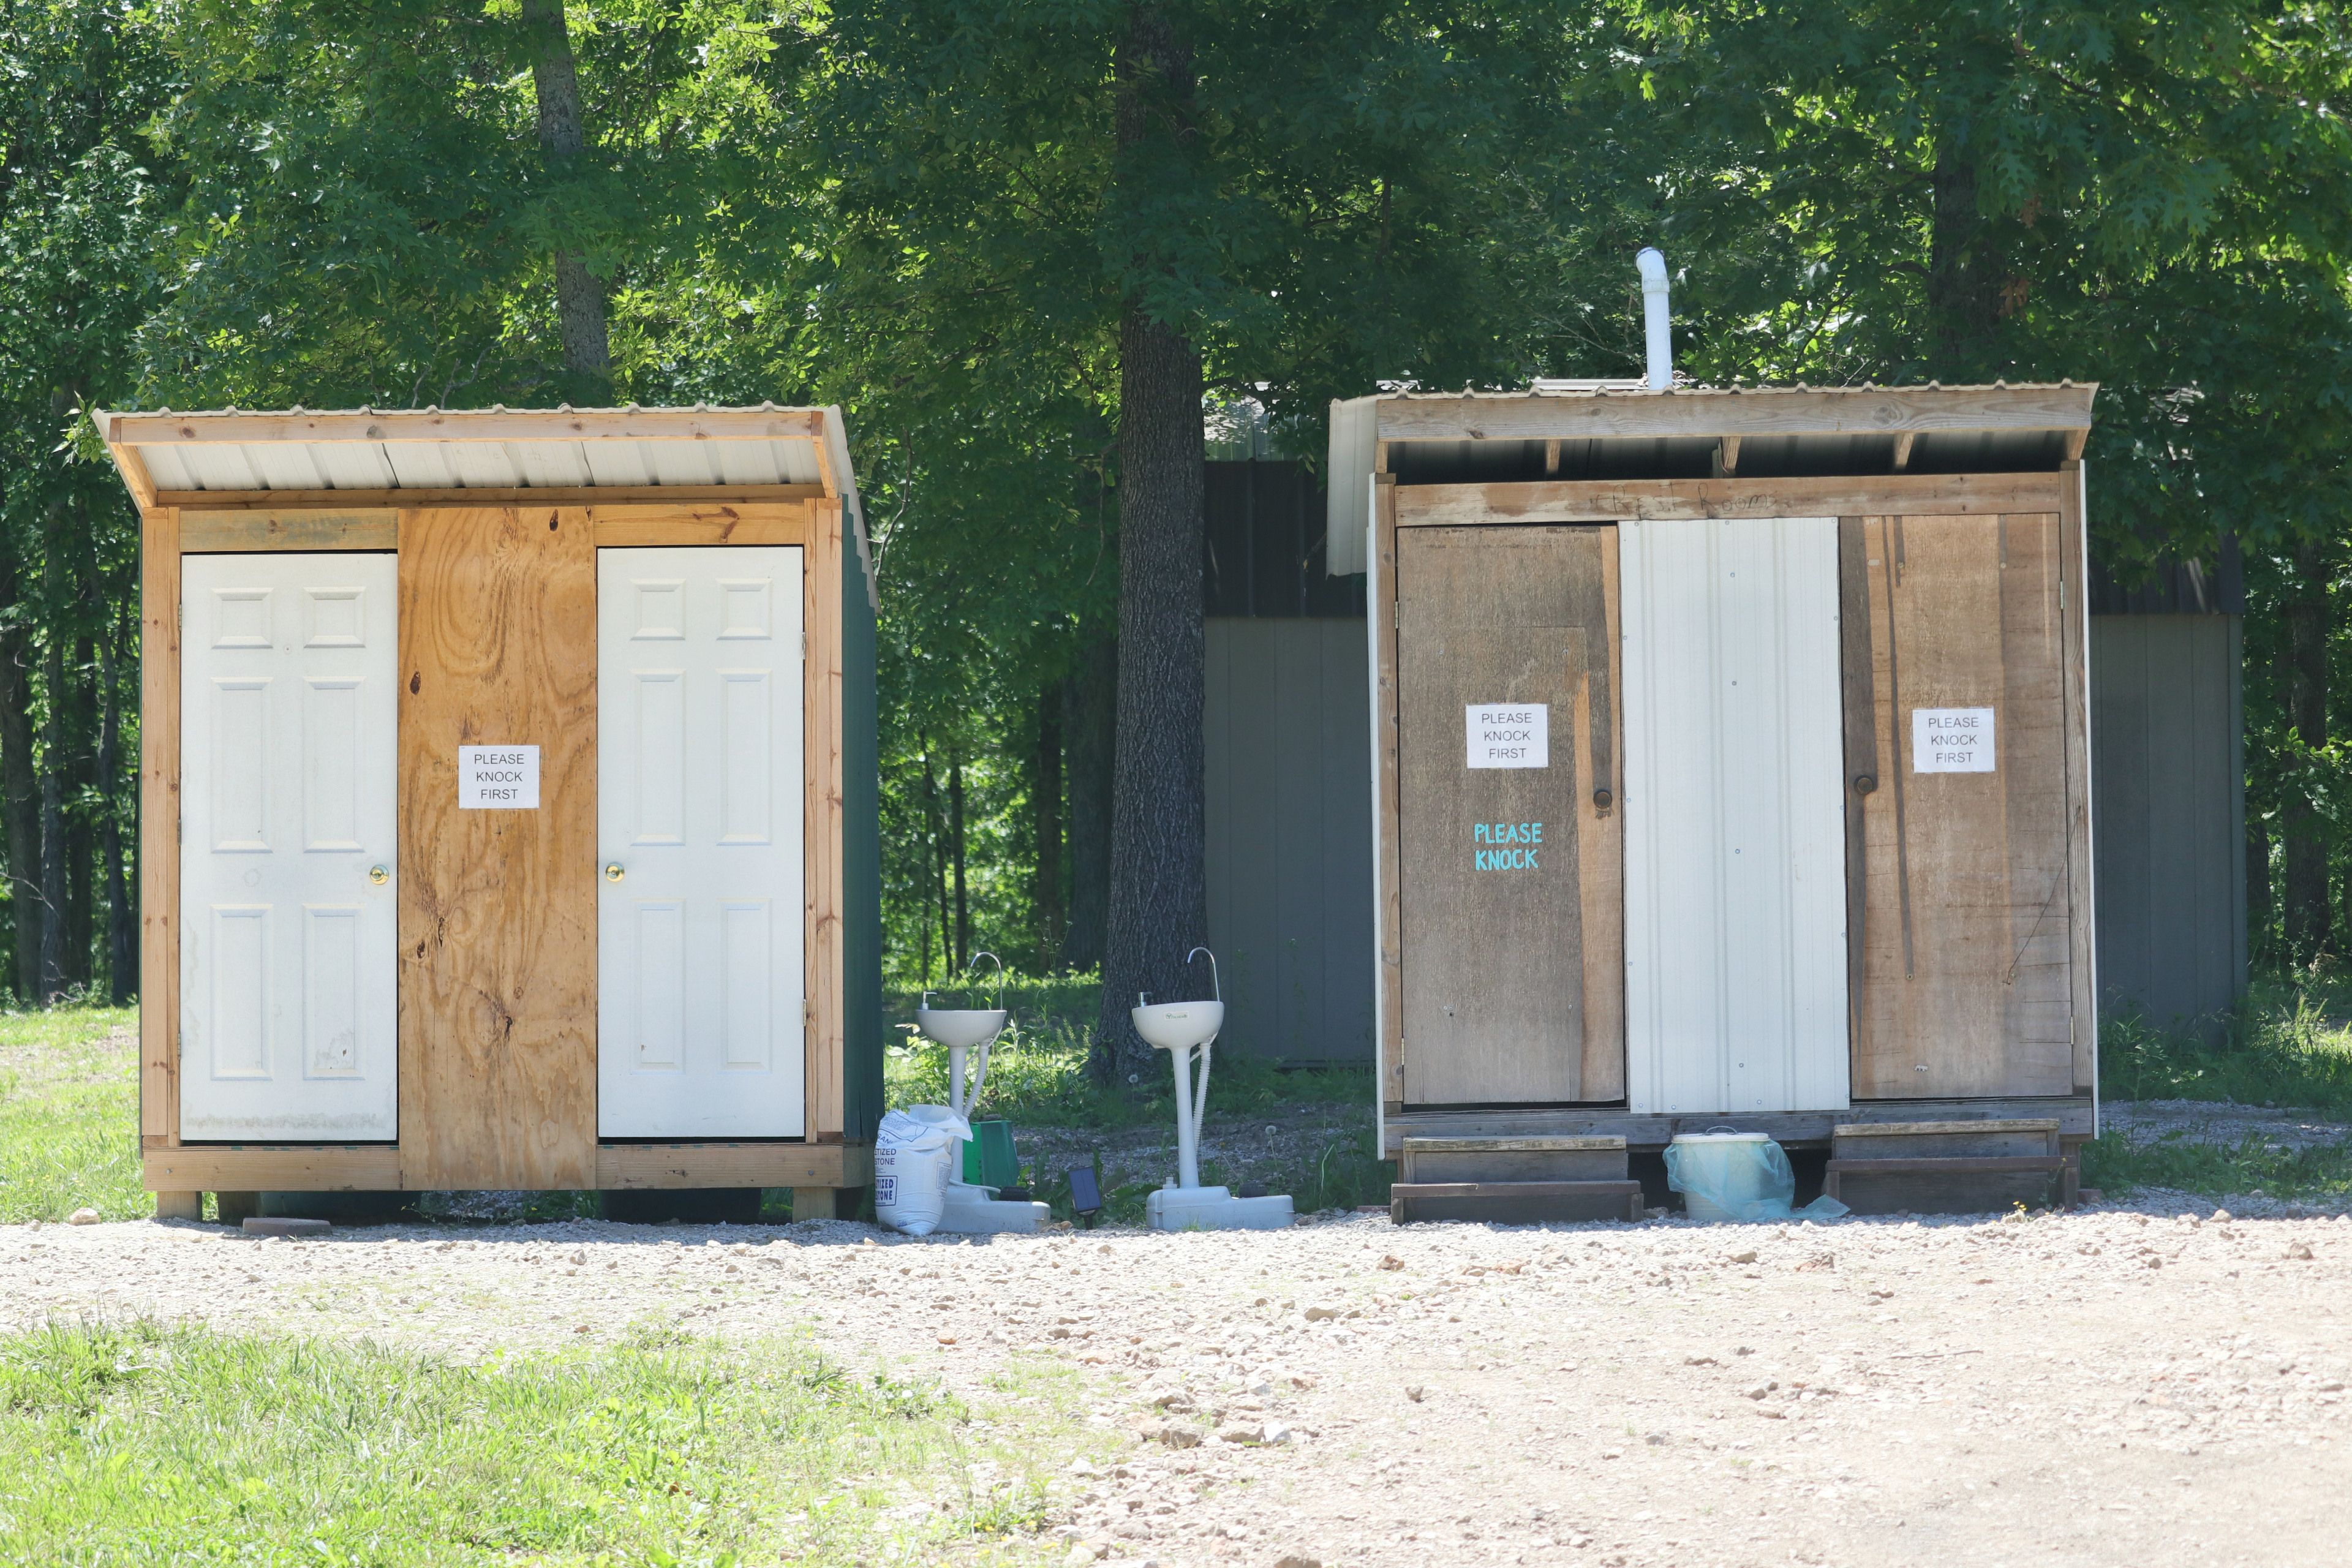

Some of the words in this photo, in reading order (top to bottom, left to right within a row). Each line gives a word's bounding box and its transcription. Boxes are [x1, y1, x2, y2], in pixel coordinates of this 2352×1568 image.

[1481, 712, 1532, 724] PLEASE
[1928, 717, 1979, 728] PLEASE
[1483, 730, 1531, 742] KNOCK
[1931, 734, 1978, 746] KNOCK
[474, 754, 525, 764] PLEASE
[1489, 748, 1526, 759] FIRST
[1936, 752, 1973, 763] FIRST
[477, 771, 522, 782] KNOCK
[481, 789, 518, 799] FIRST
[1474, 823, 1543, 844] PLEASE
[1475, 848, 1539, 871] KNOCK
